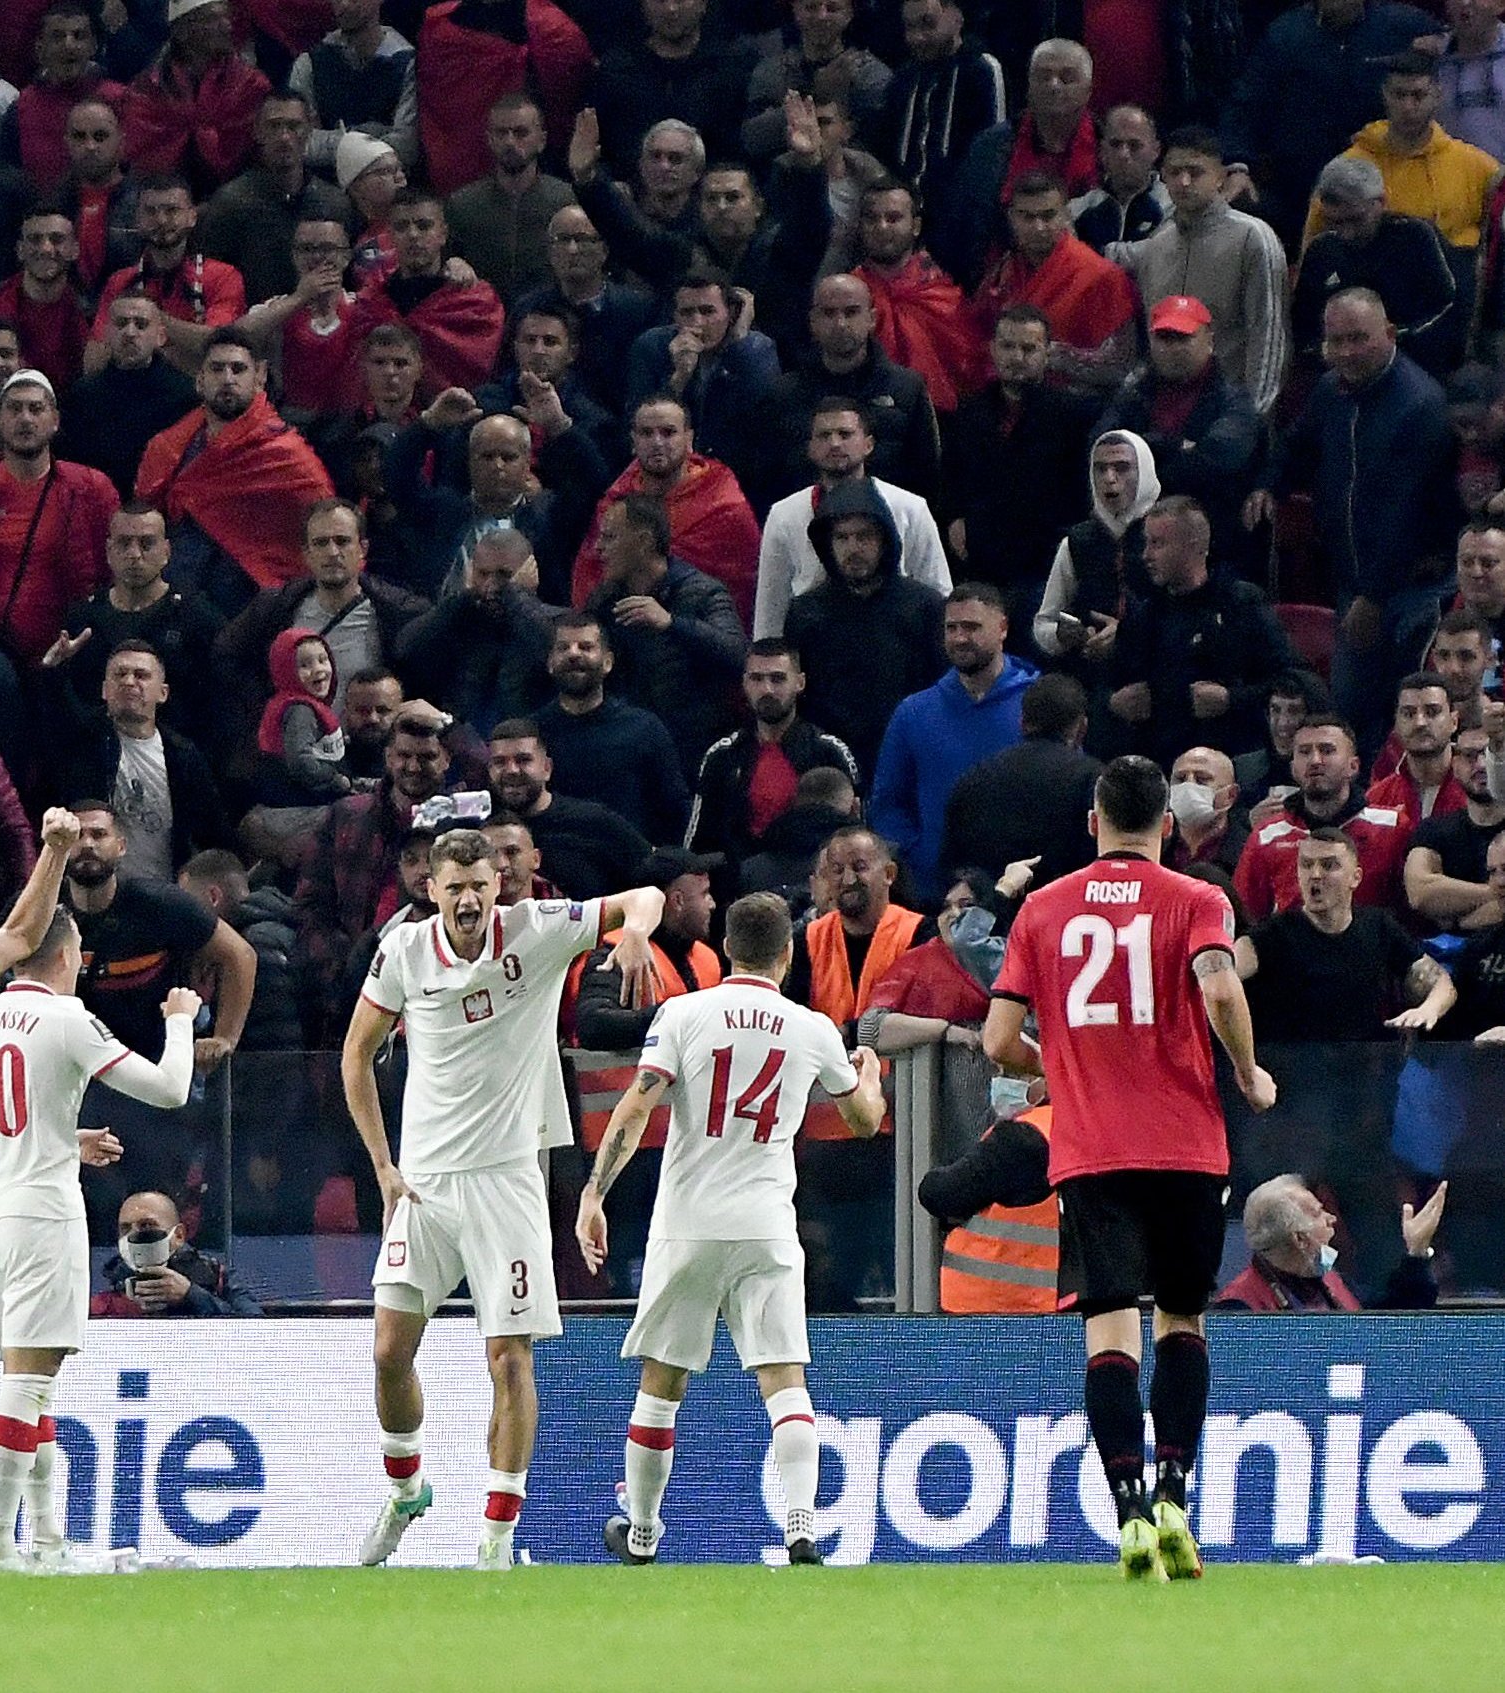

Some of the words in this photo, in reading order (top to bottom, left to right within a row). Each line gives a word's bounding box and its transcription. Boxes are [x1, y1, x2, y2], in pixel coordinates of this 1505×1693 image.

[1084, 880, 1142, 904] ROSHI
[1061, 913, 1155, 1028] 21
[724, 1008, 784, 1036] KLICH
[706, 1043, 787, 1144] 14
[510, 1260, 528, 1299] 3
